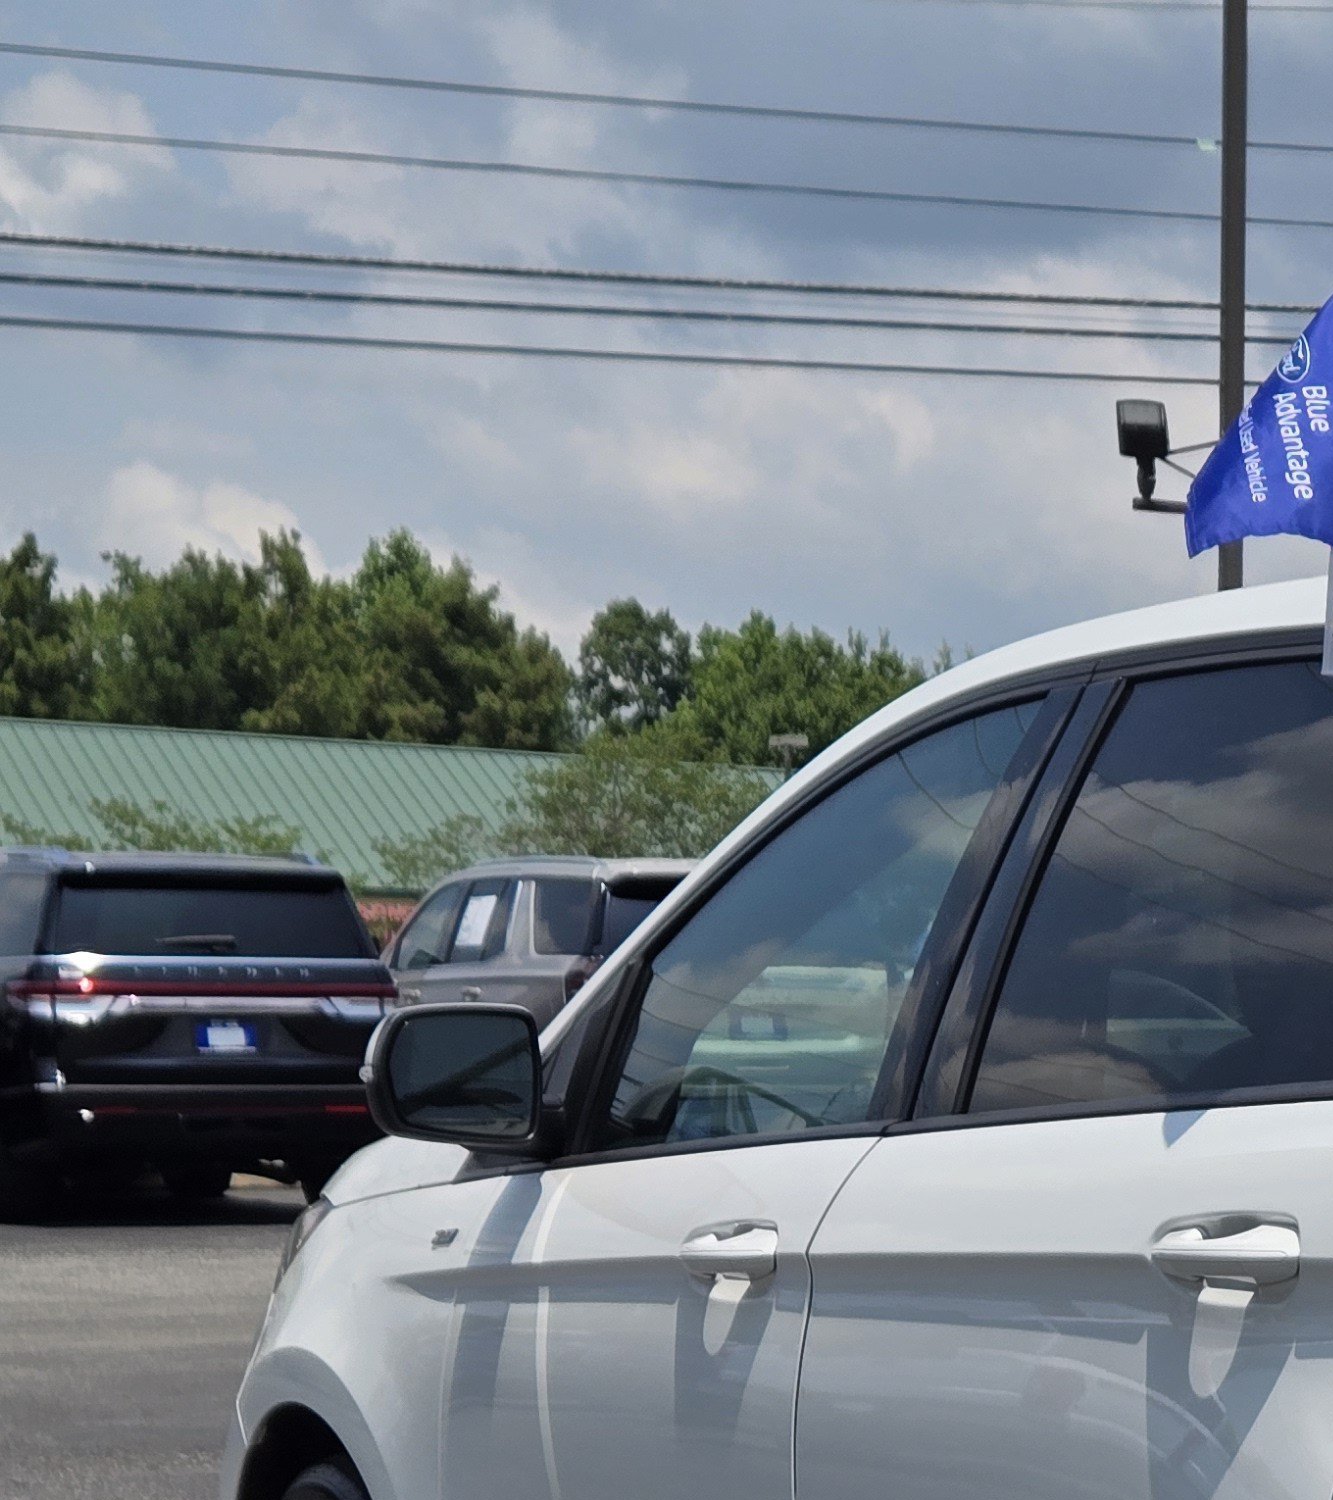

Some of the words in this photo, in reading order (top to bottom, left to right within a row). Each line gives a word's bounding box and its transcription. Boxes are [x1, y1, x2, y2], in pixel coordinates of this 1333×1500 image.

[1302, 385, 1331, 432] Blue
[1272, 392, 1314, 499] Advantage
[1244, 451, 1269, 503] Vehicle
